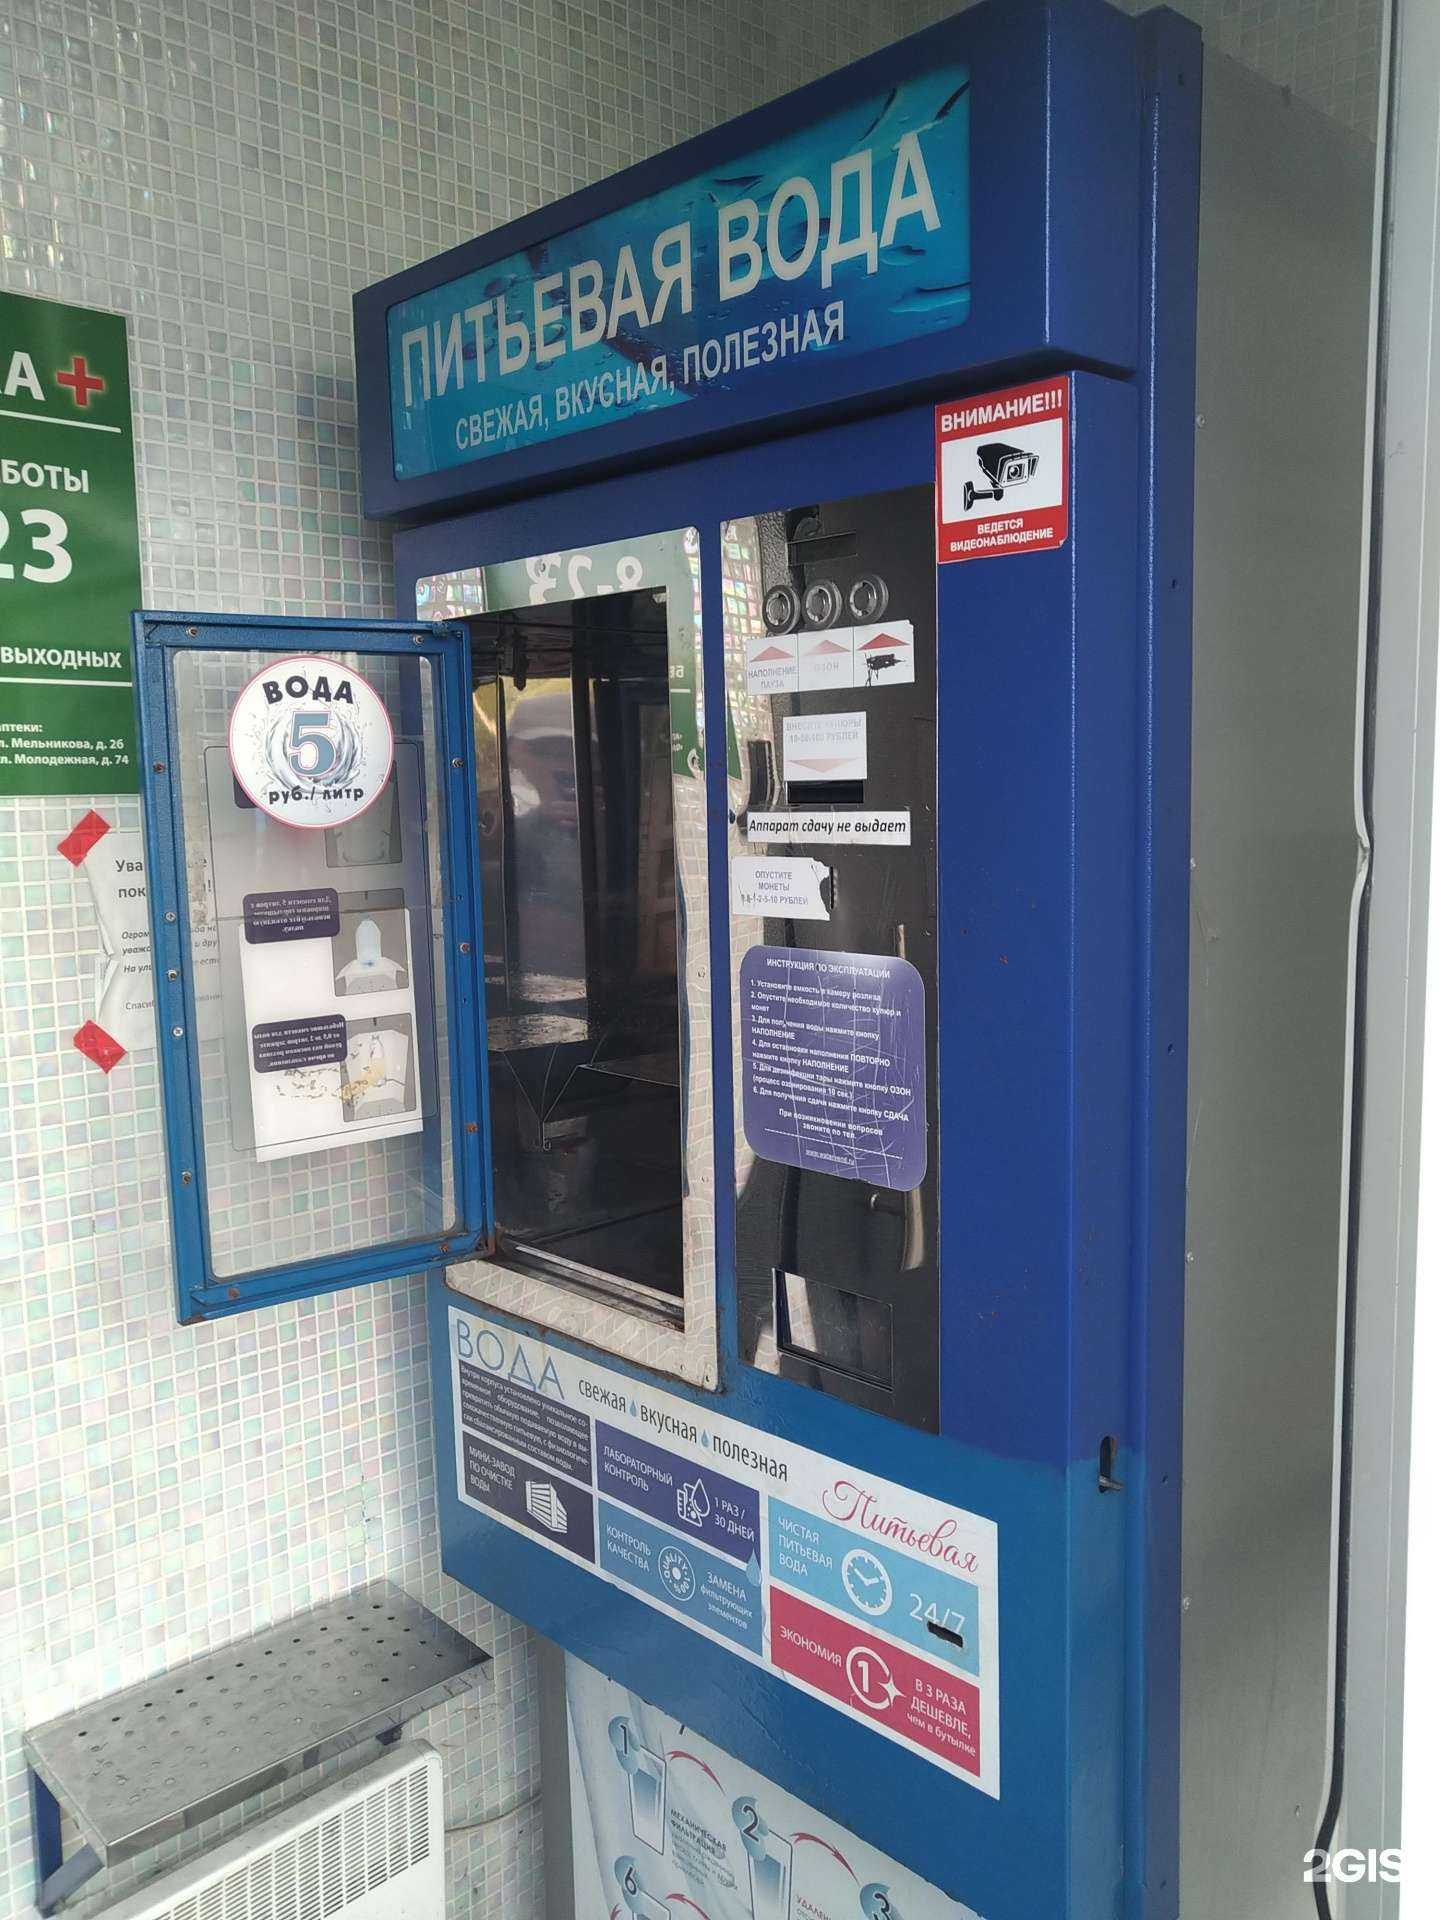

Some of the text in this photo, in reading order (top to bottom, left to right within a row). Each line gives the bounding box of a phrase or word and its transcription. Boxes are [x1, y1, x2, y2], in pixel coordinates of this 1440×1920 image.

[401, 132, 942, 408] ПИТЬЕВАЯ ВОДА
[456, 300, 844, 450] СВЕЖАЯ, ВКУСНАЯ, ПОЛЕЗНАЯ
[941, 388, 1062, 433] ВНИМАНИЕ!!!
[950, 527, 1054, 553] ВИДЕОНАБЛЮДЕНИЕ
[977, 518, 1024, 535] ВЕДЕТСЯ
[1, 646, 122, 670] ВЫХОДНЫХ
[262, 675, 354, 704] ВОДА
[0, 722, 43, 733] птеки:
[11, 738, 94, 750] Мельникова,
[109, 739, 124, 749] 26
[289, 711, 336, 777] 5
[14, 754, 99, 767] Молодежная,
[115, 755, 129, 765] 74
[322, 786, 364, 802] литр
[750, 819, 906, 835] Аппарат сдачу не выдает
[755, 871, 792, 880] ОПУСТИТЕ
[758, 882, 790, 891] МОНЕТЫ
[767, 958, 814, 971] ИНСТРУКЦИЯ
[829, 964, 890, 978] ЭКСПЛУАТАЦИИ
[752, 1026, 795, 1039] НАПОЛНЕНИЕ
[758, 1015, 770, 1024] Для
[758, 1039, 771, 1048] Для
[850, 1054, 890, 1067] ПОВТОРНО
[802, 1059, 849, 1073] НАПОЛНЕНИЕ
[759, 1087, 772, 1096] Для
[883, 1110, 909, 1121] СДАЧА
[889, 1086, 911, 1096] ОЗОН
[779, 1108, 792, 1118] При
[456, 1318, 565, 1400] ВОДА
[578, 1378, 788, 1482] свежая вкусная полезная
[469, 1446, 516, 1479] МИНИ-ЗАВОД
[469, 1460, 513, 1490] ПО ОЧИСТКЕ
[603, 1445, 674, 1487] ЛАБОРАТОРНЫЙ
[603, 1462, 650, 1492] КОНТРОЛЬ
[470, 1474, 490, 1492] ВОДЫ
[714, 1497, 719, 1510] 1
[721, 1500, 741, 1518] РАЗ
[607, 1524, 652, 1556] КОНТРОЛЬ
[714, 1514, 755, 1542] 30 ДНЕЙ
[779, 1516, 820, 1545] ЧИСТАЯ
[822, 1480, 979, 1573] Питьевая
[607, 1540, 650, 1572] КАЧЕСТВА
[779, 1535, 833, 1570] ПИТЬЕВАЯ
[779, 1553, 808, 1577] ВОДА
[706, 1571, 747, 1601] ЗАМЕНА
[909, 1593, 966, 1635] 24/7
[779, 1625, 842, 1668] ЭКОНОМИЯ
[857, 1660, 870, 1694] 1
[915, 1678, 967, 1715] В 3 РАЗА
[910, 1696, 972, 1739] ДЕШЕВЛЕ,
[906, 1712, 977, 1758] чем в бутылке
[742, 1805, 759, 1842] 2
[624, 1865, 637, 1896] 6
